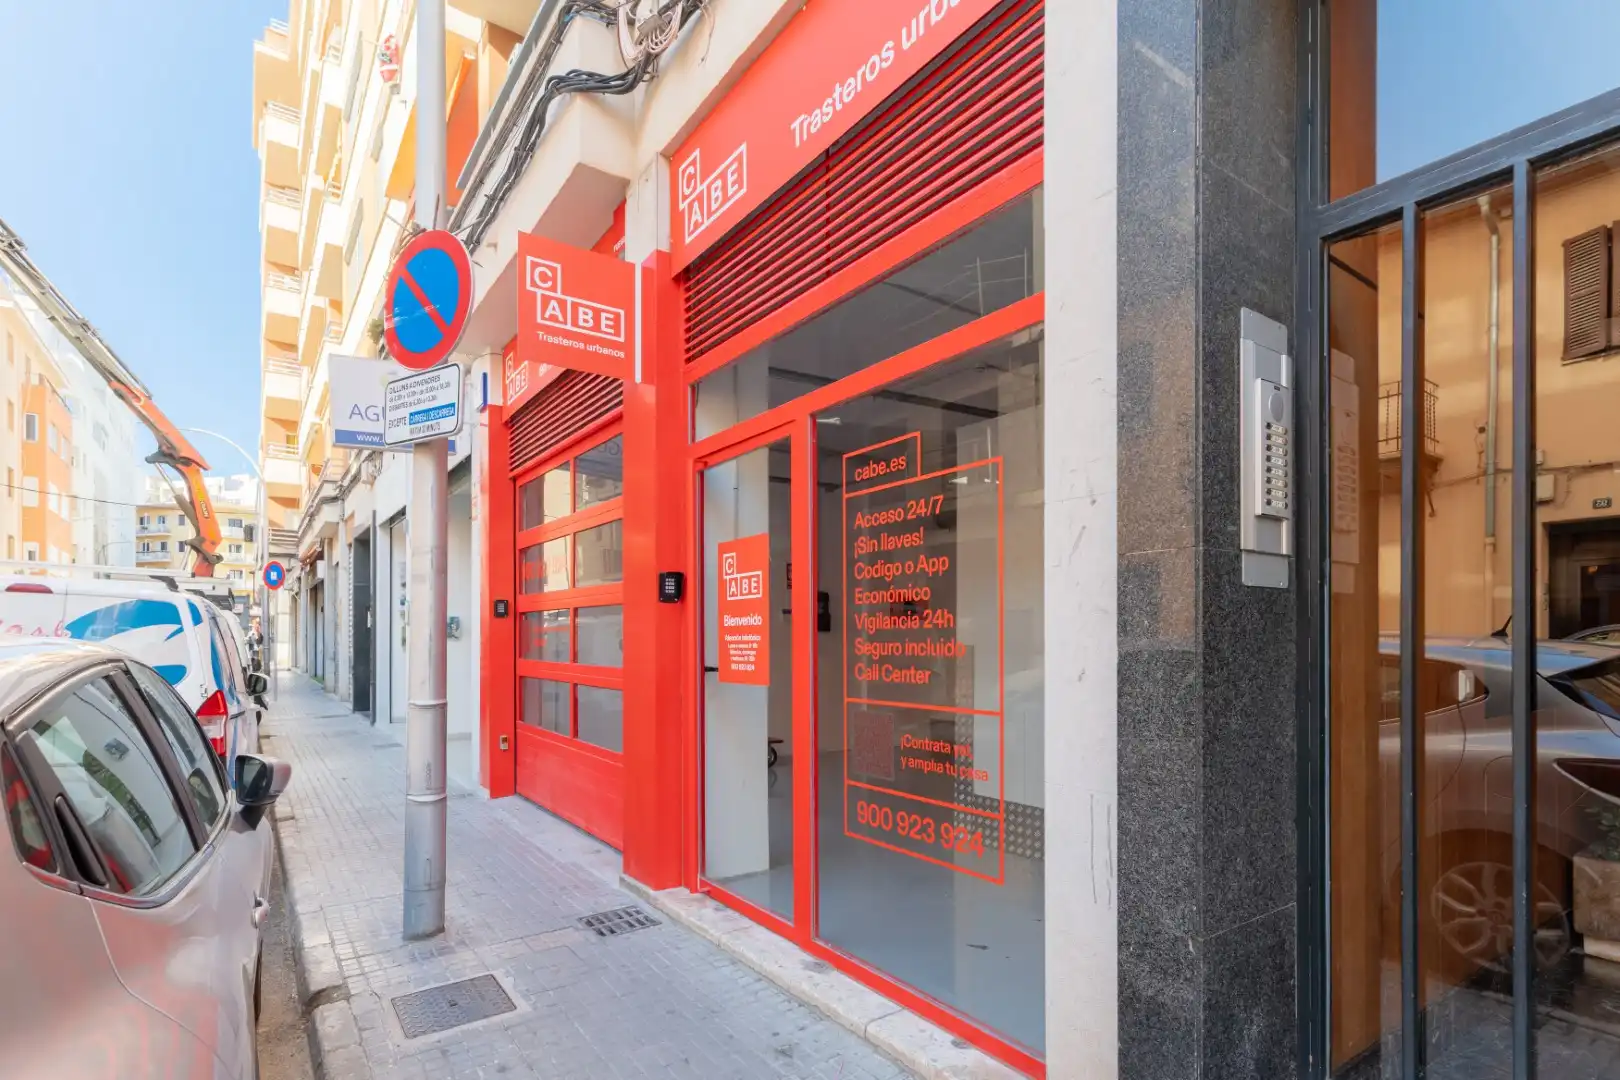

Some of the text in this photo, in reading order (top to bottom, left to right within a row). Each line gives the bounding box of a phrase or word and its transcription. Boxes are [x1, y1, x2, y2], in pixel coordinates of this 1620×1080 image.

[790, 0, 960, 148] Trasteros urb
[536, 330, 625, 359] Trasteros urbanos
[349, 403, 384, 422] AG
[855, 455, 906, 482] cabe.es
[854, 495, 944, 529] Acceso 24/7
[854, 527, 924, 559] ¡Sin llaves!
[854, 554, 949, 582] Codigo o App
[855, 585, 931, 605] Económico
[724, 613, 762, 627] Bienvenido
[855, 609, 954, 635] Vigilancia 24h
[854, 639, 966, 660] Seguro incluido
[854, 663, 931, 685] Call Center
[900, 755, 907, 770] y
[945, 761, 958, 777] tu
[960, 766, 988, 782] casa
[857, 800, 984, 859] 900 923 924
